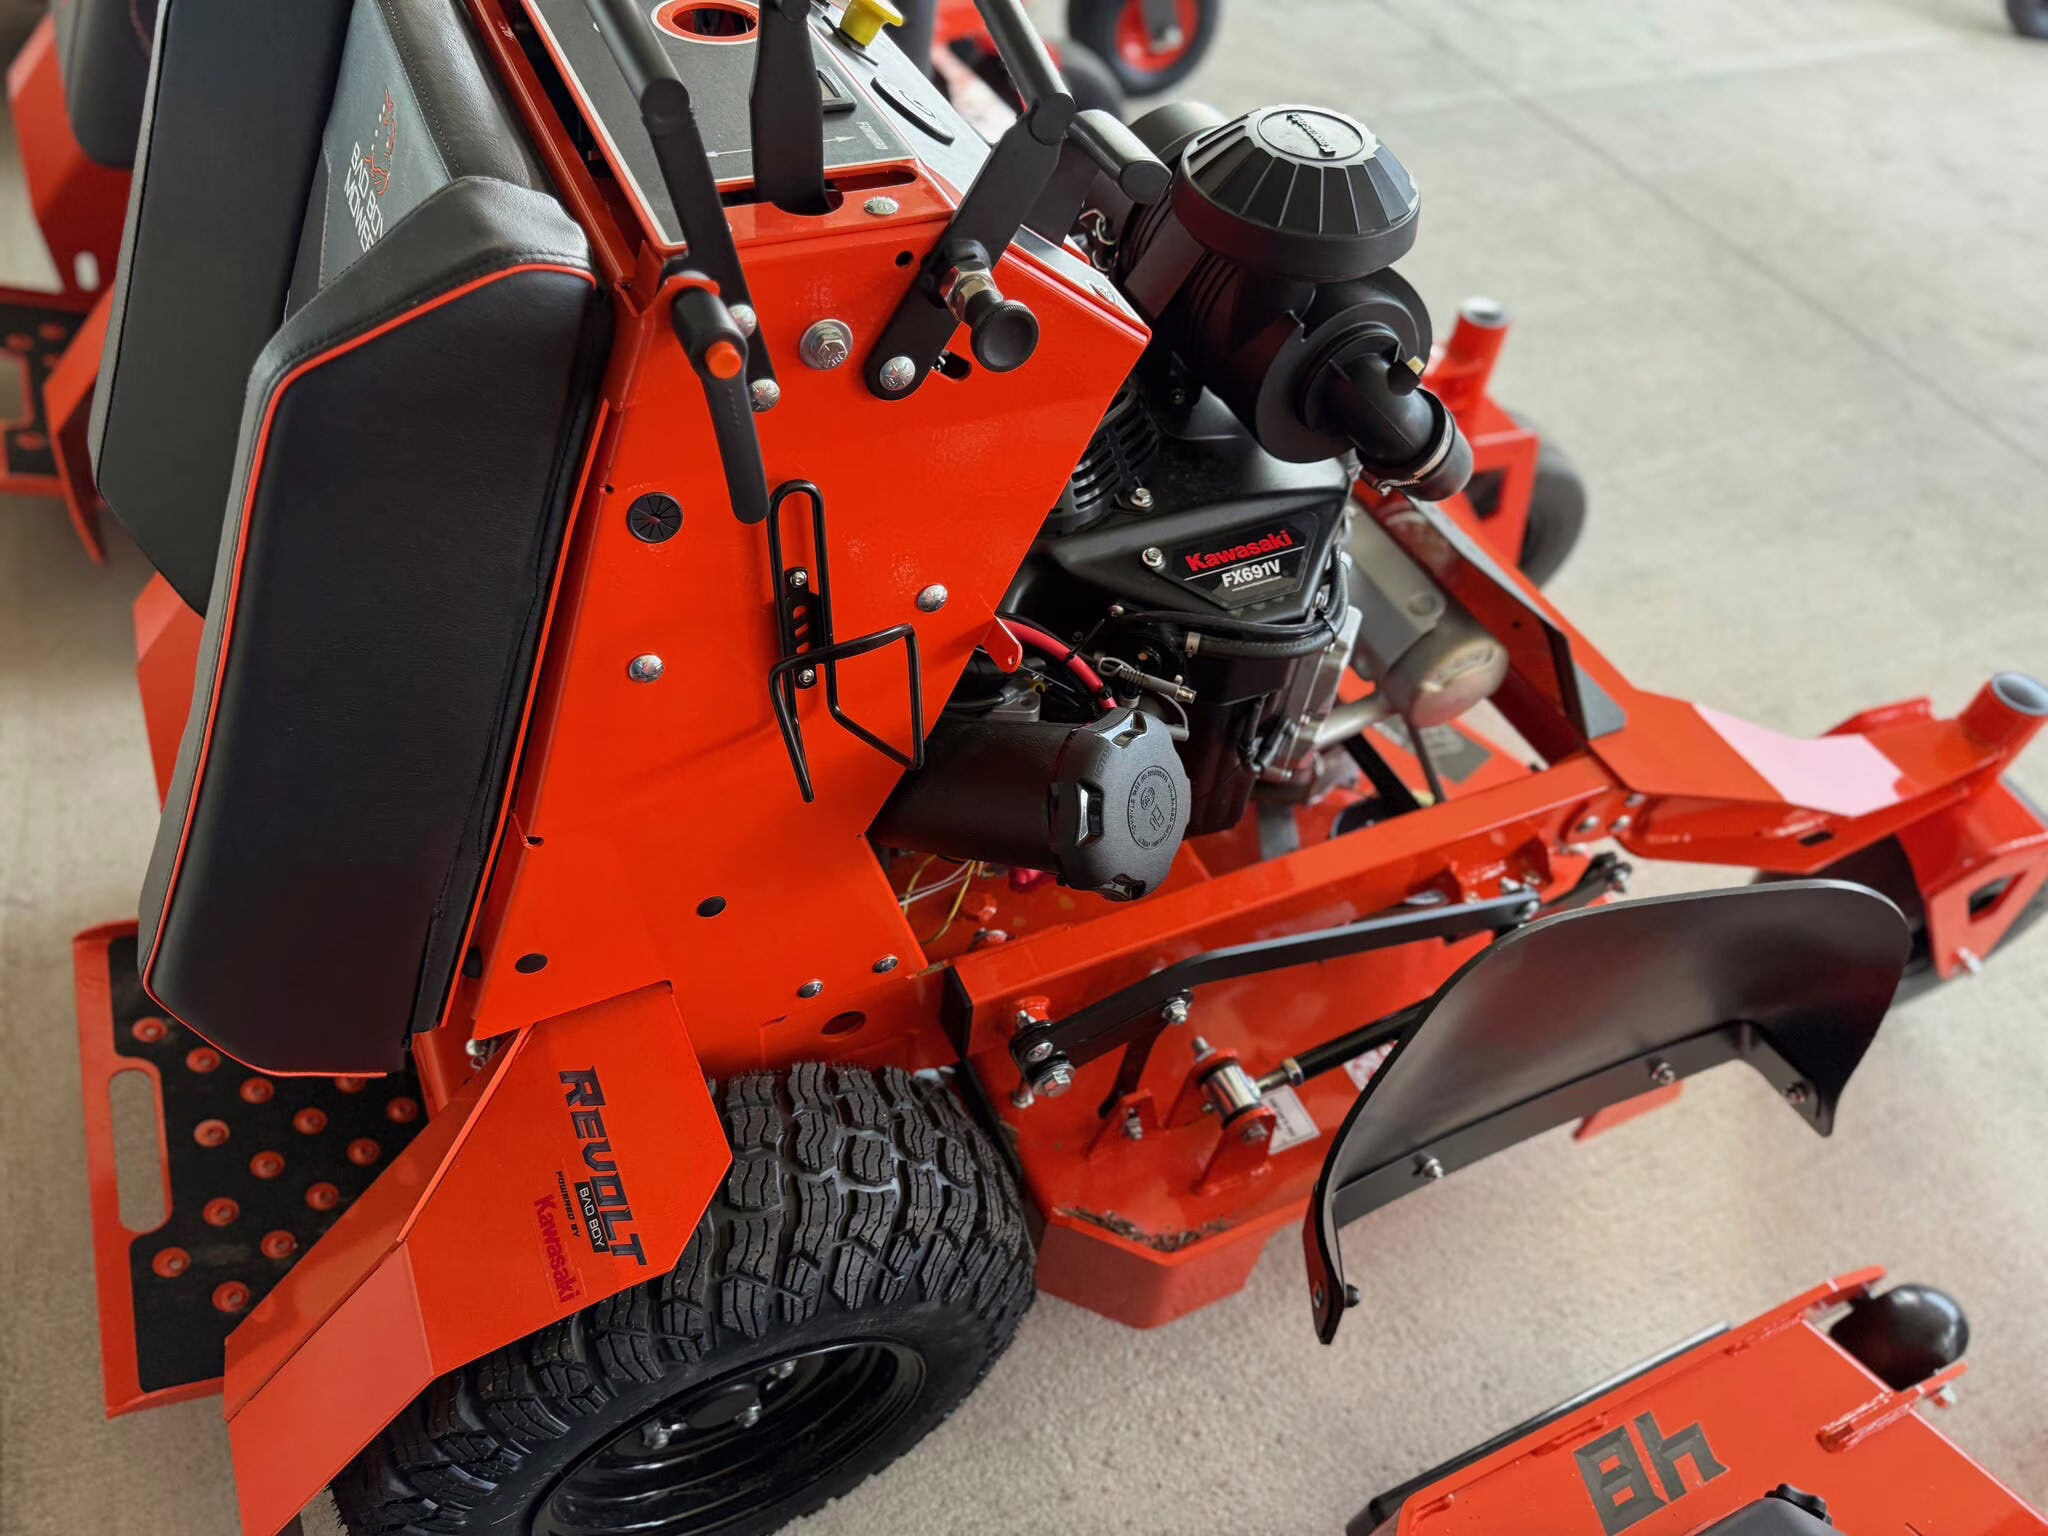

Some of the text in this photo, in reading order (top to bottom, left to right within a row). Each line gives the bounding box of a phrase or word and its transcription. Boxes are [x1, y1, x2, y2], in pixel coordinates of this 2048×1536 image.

[351, 142, 369, 199] BAD
[1185, 530, 1293, 572] Kawasaki
[1221, 559, 1280, 588] FX691V
[559, 1066, 647, 1265] REVOLT
[556, 1170, 580, 1238] POWERED BY
[580, 1187, 605, 1247] BAD BOY
[534, 1194, 581, 1303] Kawasaki
